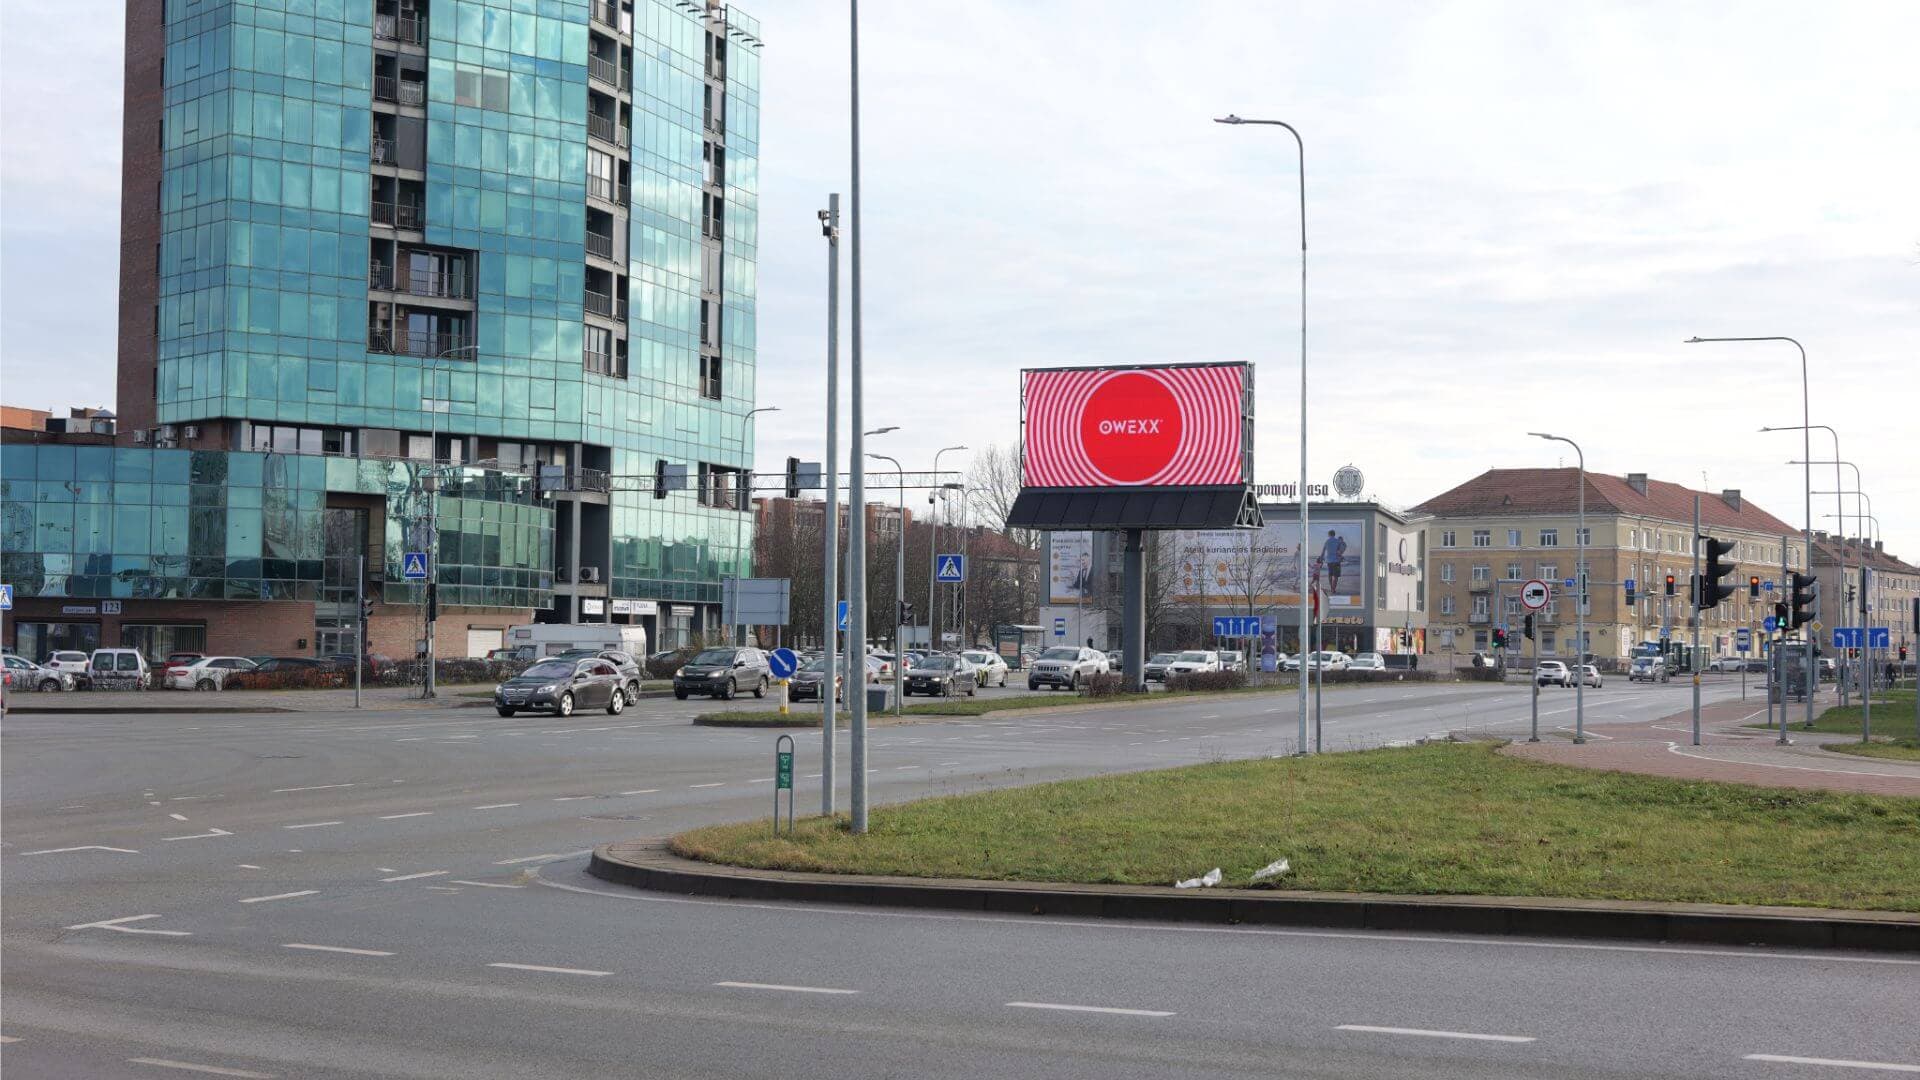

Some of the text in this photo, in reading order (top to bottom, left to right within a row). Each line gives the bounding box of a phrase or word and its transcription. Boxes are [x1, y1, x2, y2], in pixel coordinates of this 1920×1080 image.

[1099, 420, 1160, 435] OWEXX
[1252, 481, 1329, 498] pomoji asa
[104, 602, 120, 612] 123
